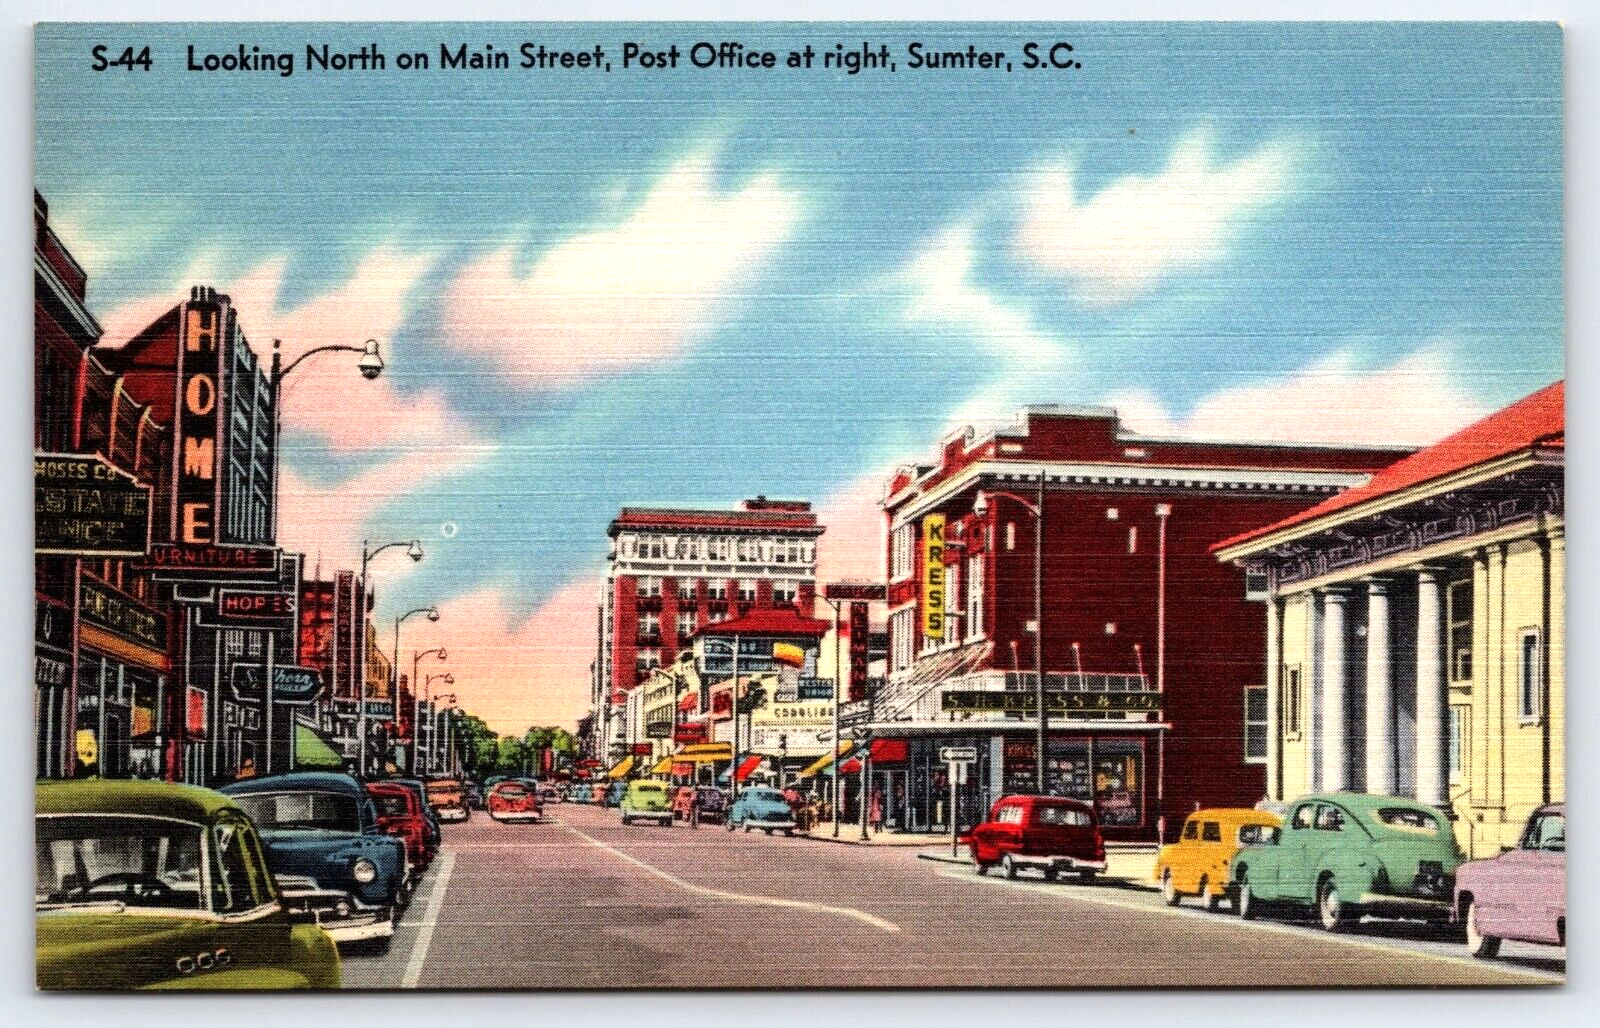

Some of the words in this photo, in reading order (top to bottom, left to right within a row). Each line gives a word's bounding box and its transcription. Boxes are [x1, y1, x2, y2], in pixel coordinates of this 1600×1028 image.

[182, 308, 218, 545] HOME
[35, 462, 88, 479] MOSES
[153, 549, 258, 565] URNITURE
[928, 522, 944, 631] KRESS
[1004, 694, 1085, 709] KRSS
